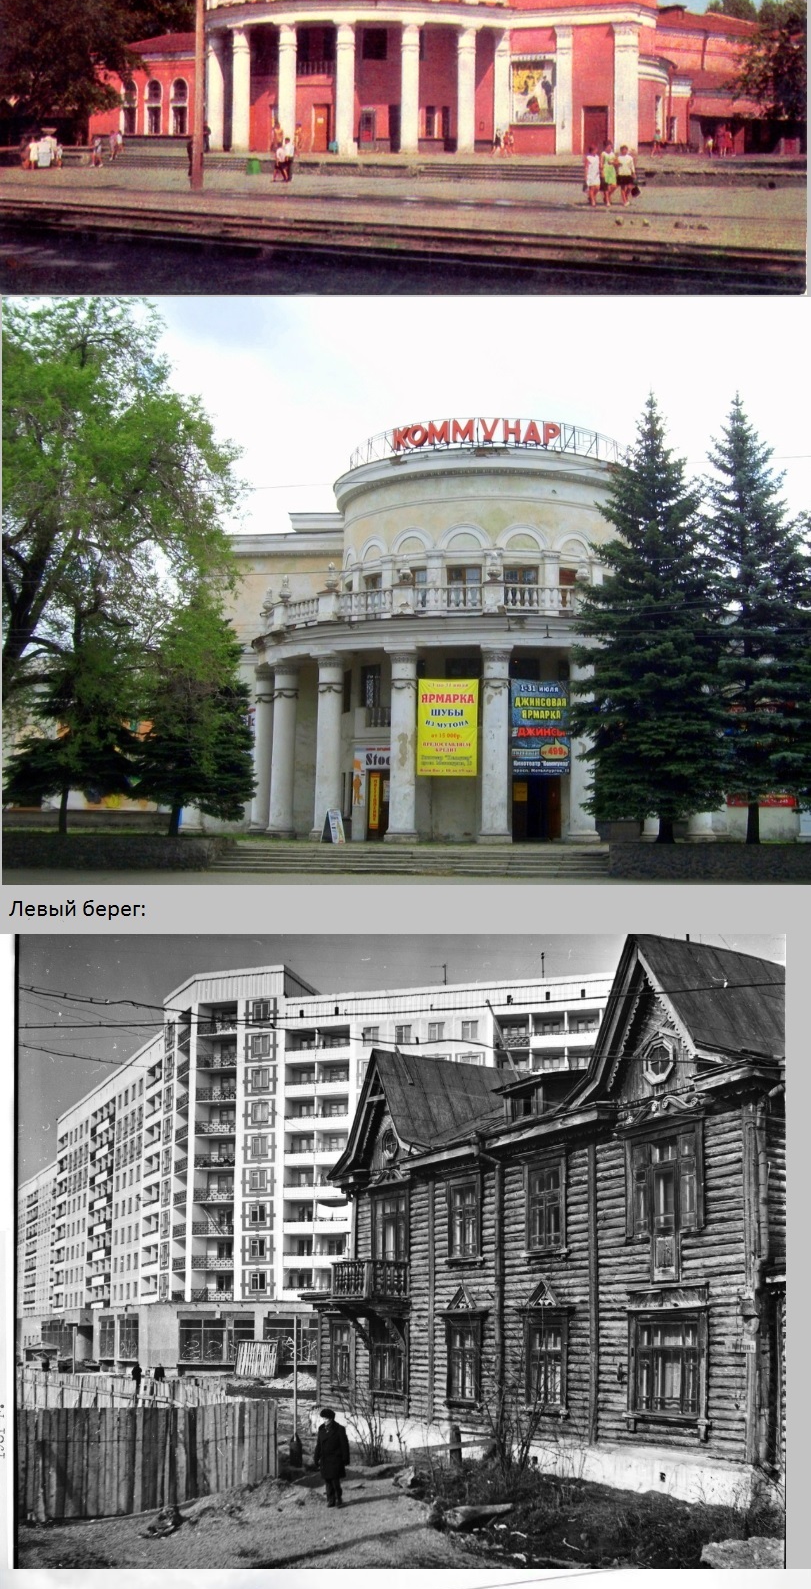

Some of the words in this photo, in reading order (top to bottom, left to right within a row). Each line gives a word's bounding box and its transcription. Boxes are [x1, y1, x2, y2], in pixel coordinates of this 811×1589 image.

[392, 417, 562, 452] КОММУНАР
[520, 684, 536, 692] 1-31
[421, 693, 475, 704] ЯРМАРКА
[514, 696, 567, 708] ДЖИНСОВАЯ
[430, 709, 464, 717] ШУБЫ
[521, 709, 561, 720] ЯРМАРКА
[425, 719, 435, 727] ИЗ
[437, 720, 469, 728] МУТОНА
